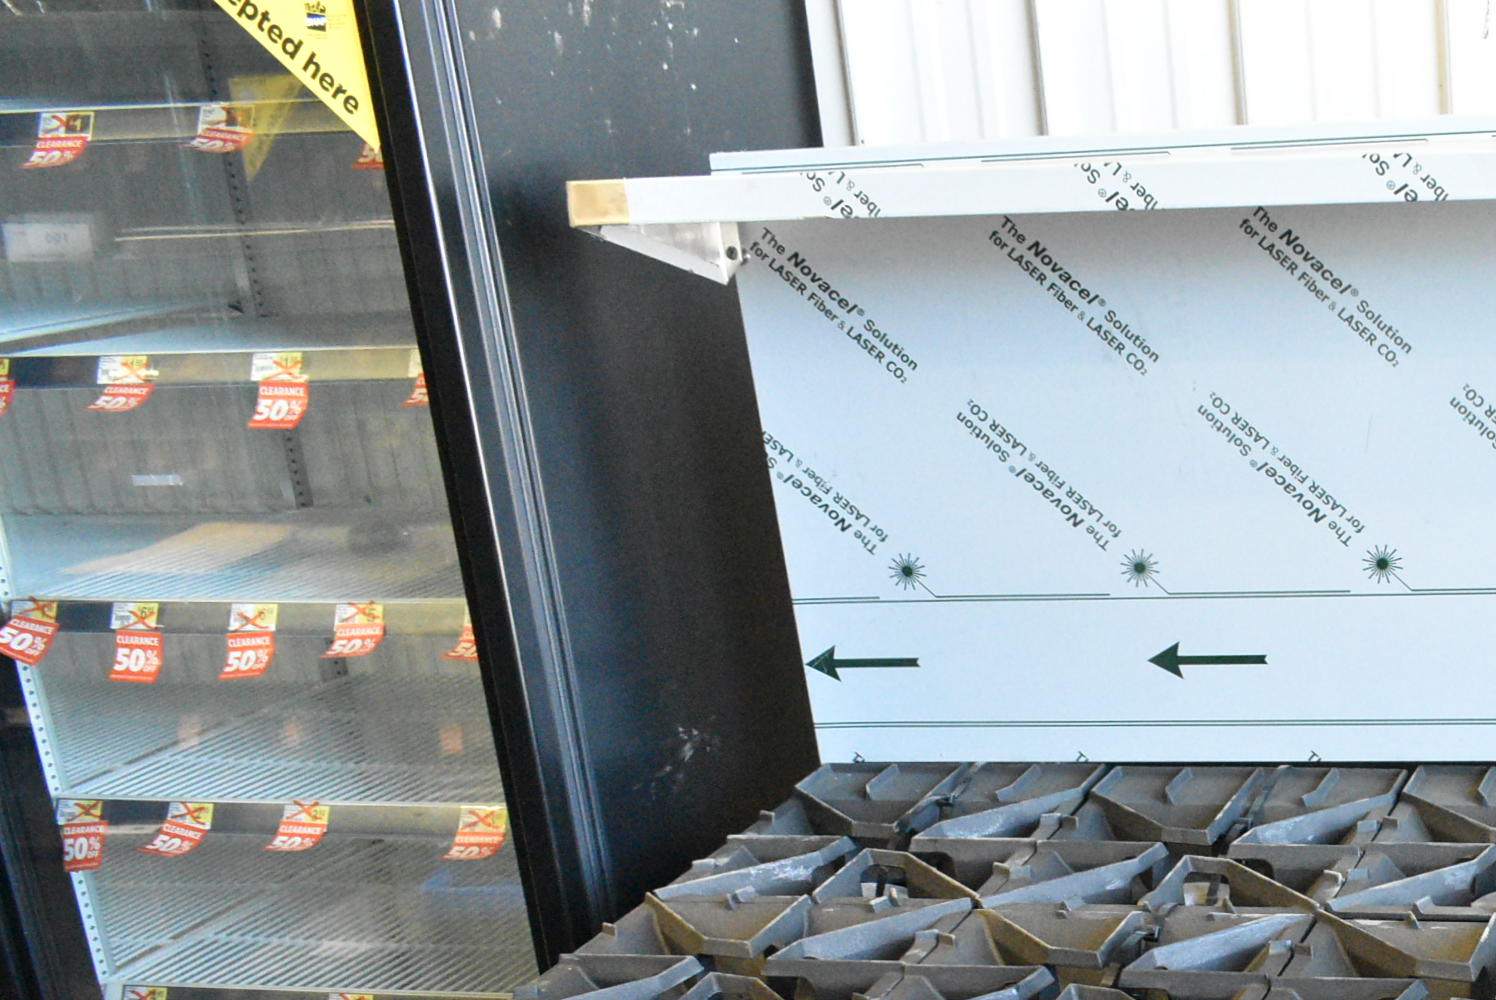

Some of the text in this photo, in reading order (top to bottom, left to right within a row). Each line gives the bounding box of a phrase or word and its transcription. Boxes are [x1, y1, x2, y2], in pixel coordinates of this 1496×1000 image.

[302, 51, 360, 115] here
[761, 226, 786, 256] The
[863, 318, 918, 371] Solution
[988, 229, 1009, 251] for
[1006, 246, 1048, 287] LASER
[1046, 281, 1079, 313] Fiber
[1085, 316, 1126, 356] LASER
[1000, 214, 1027, 245] The
[1103, 309, 1160, 363] Solution
[1239, 217, 1260, 239] for
[1257, 234, 1299, 276] LASER
[1296, 271, 1331, 303] Fiber
[1336, 306, 1378, 347] LASER
[748, 240, 770, 262] for
[767, 257, 808, 297] LASER
[806, 291, 839, 322] Fiber
[845, 325, 886, 365] LASER
[1356, 299, 1412, 355] Solution
[259, 386, 304, 396] CLEARANCE
[956, 411, 1011, 463] Solution
[988, 418, 1028, 457] LASER
[1197, 404, 1252, 457] Solution
[1230, 411, 1271, 451] LASER
[763, 431, 889, 543] for LASER Fiber LASE
[1034, 460, 1067, 490] Fiber
[1276, 454, 1310, 485] Fiber
[1065, 485, 1104, 523] LASER
[1307, 479, 1348, 518] LASER
[853, 529, 877, 556] The
[1085, 524, 1110, 552] The
[1101, 520, 1122, 539] for
[1327, 520, 1352, 548] The
[1345, 515, 1366, 534] for
[116, 635, 160, 646] CLEARANCE
[228, 637, 271, 647] CLEARANCE
[337, 626, 381, 636] CLEARANCE
